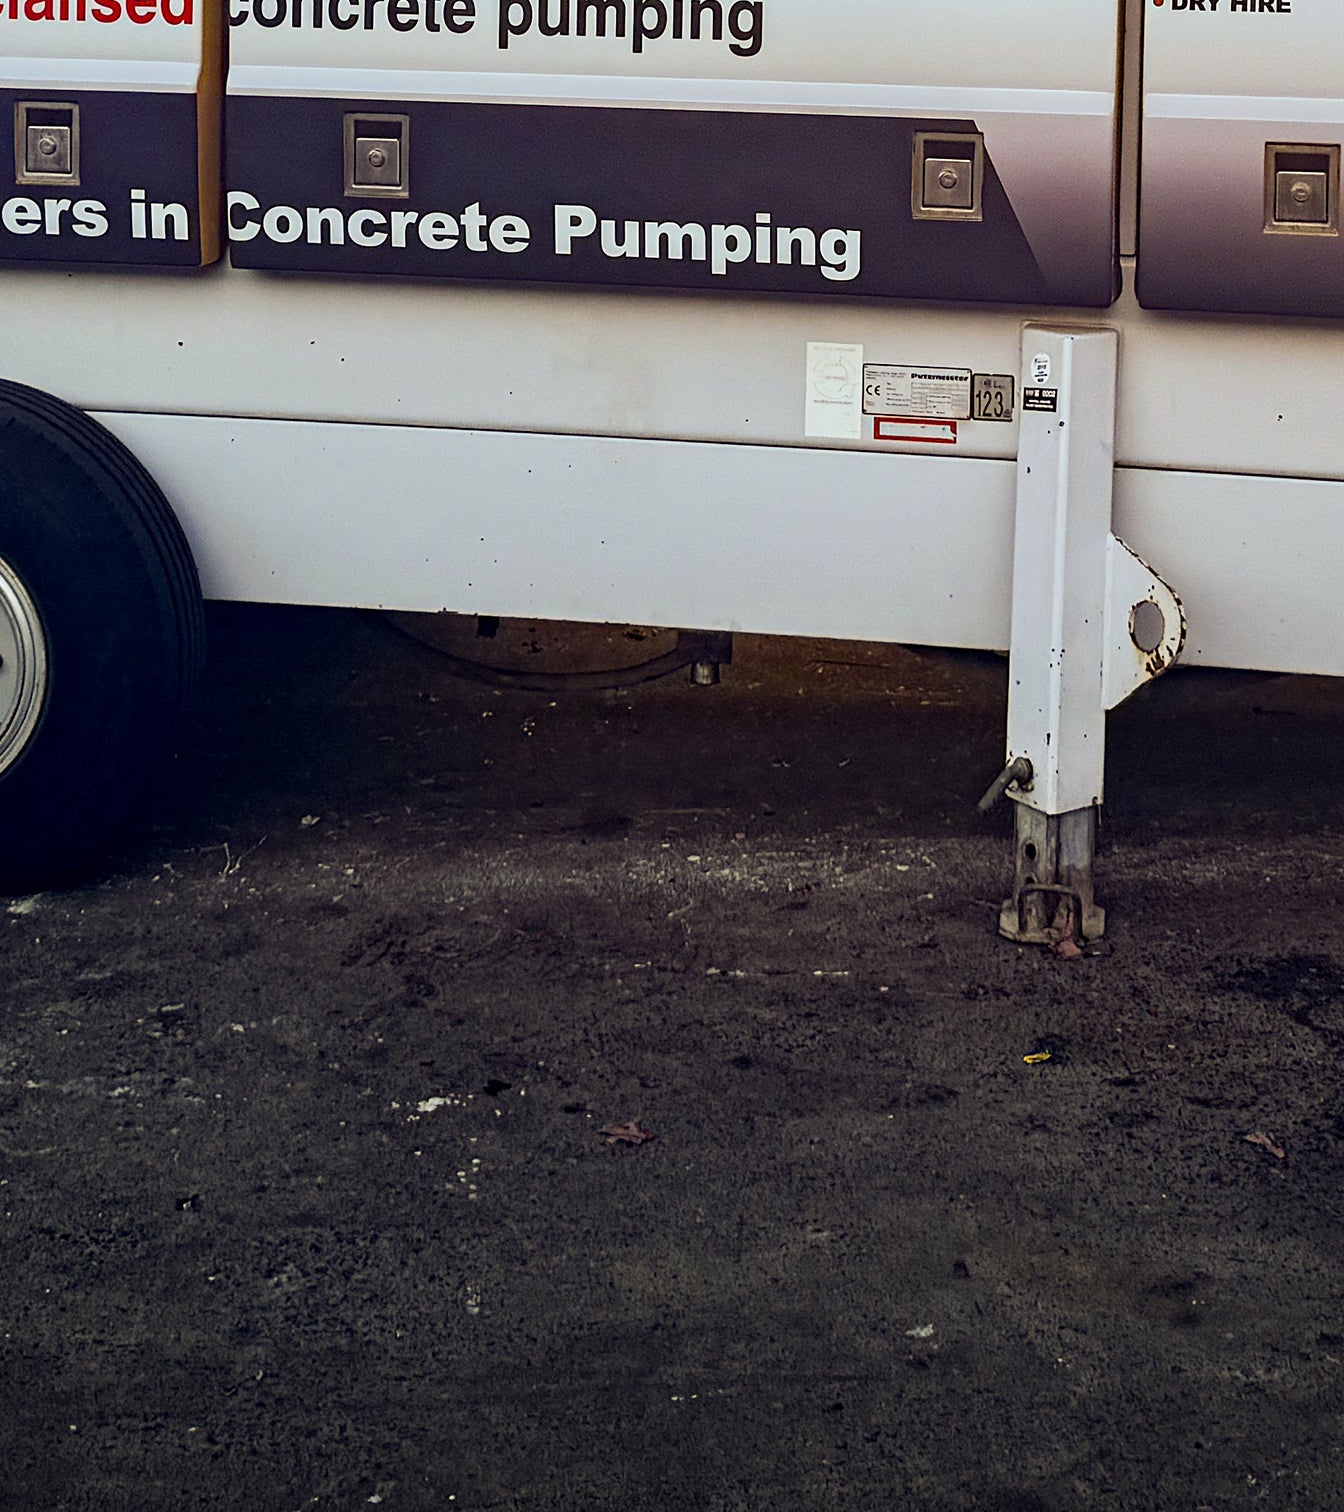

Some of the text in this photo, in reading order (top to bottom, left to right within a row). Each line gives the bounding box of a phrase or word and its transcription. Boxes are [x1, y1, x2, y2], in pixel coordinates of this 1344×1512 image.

[130, 188, 189, 241] in
[227, 190, 530, 254] Concrete
[553, 204, 862, 281] Pumping
[975, 389, 1004, 417] 123
